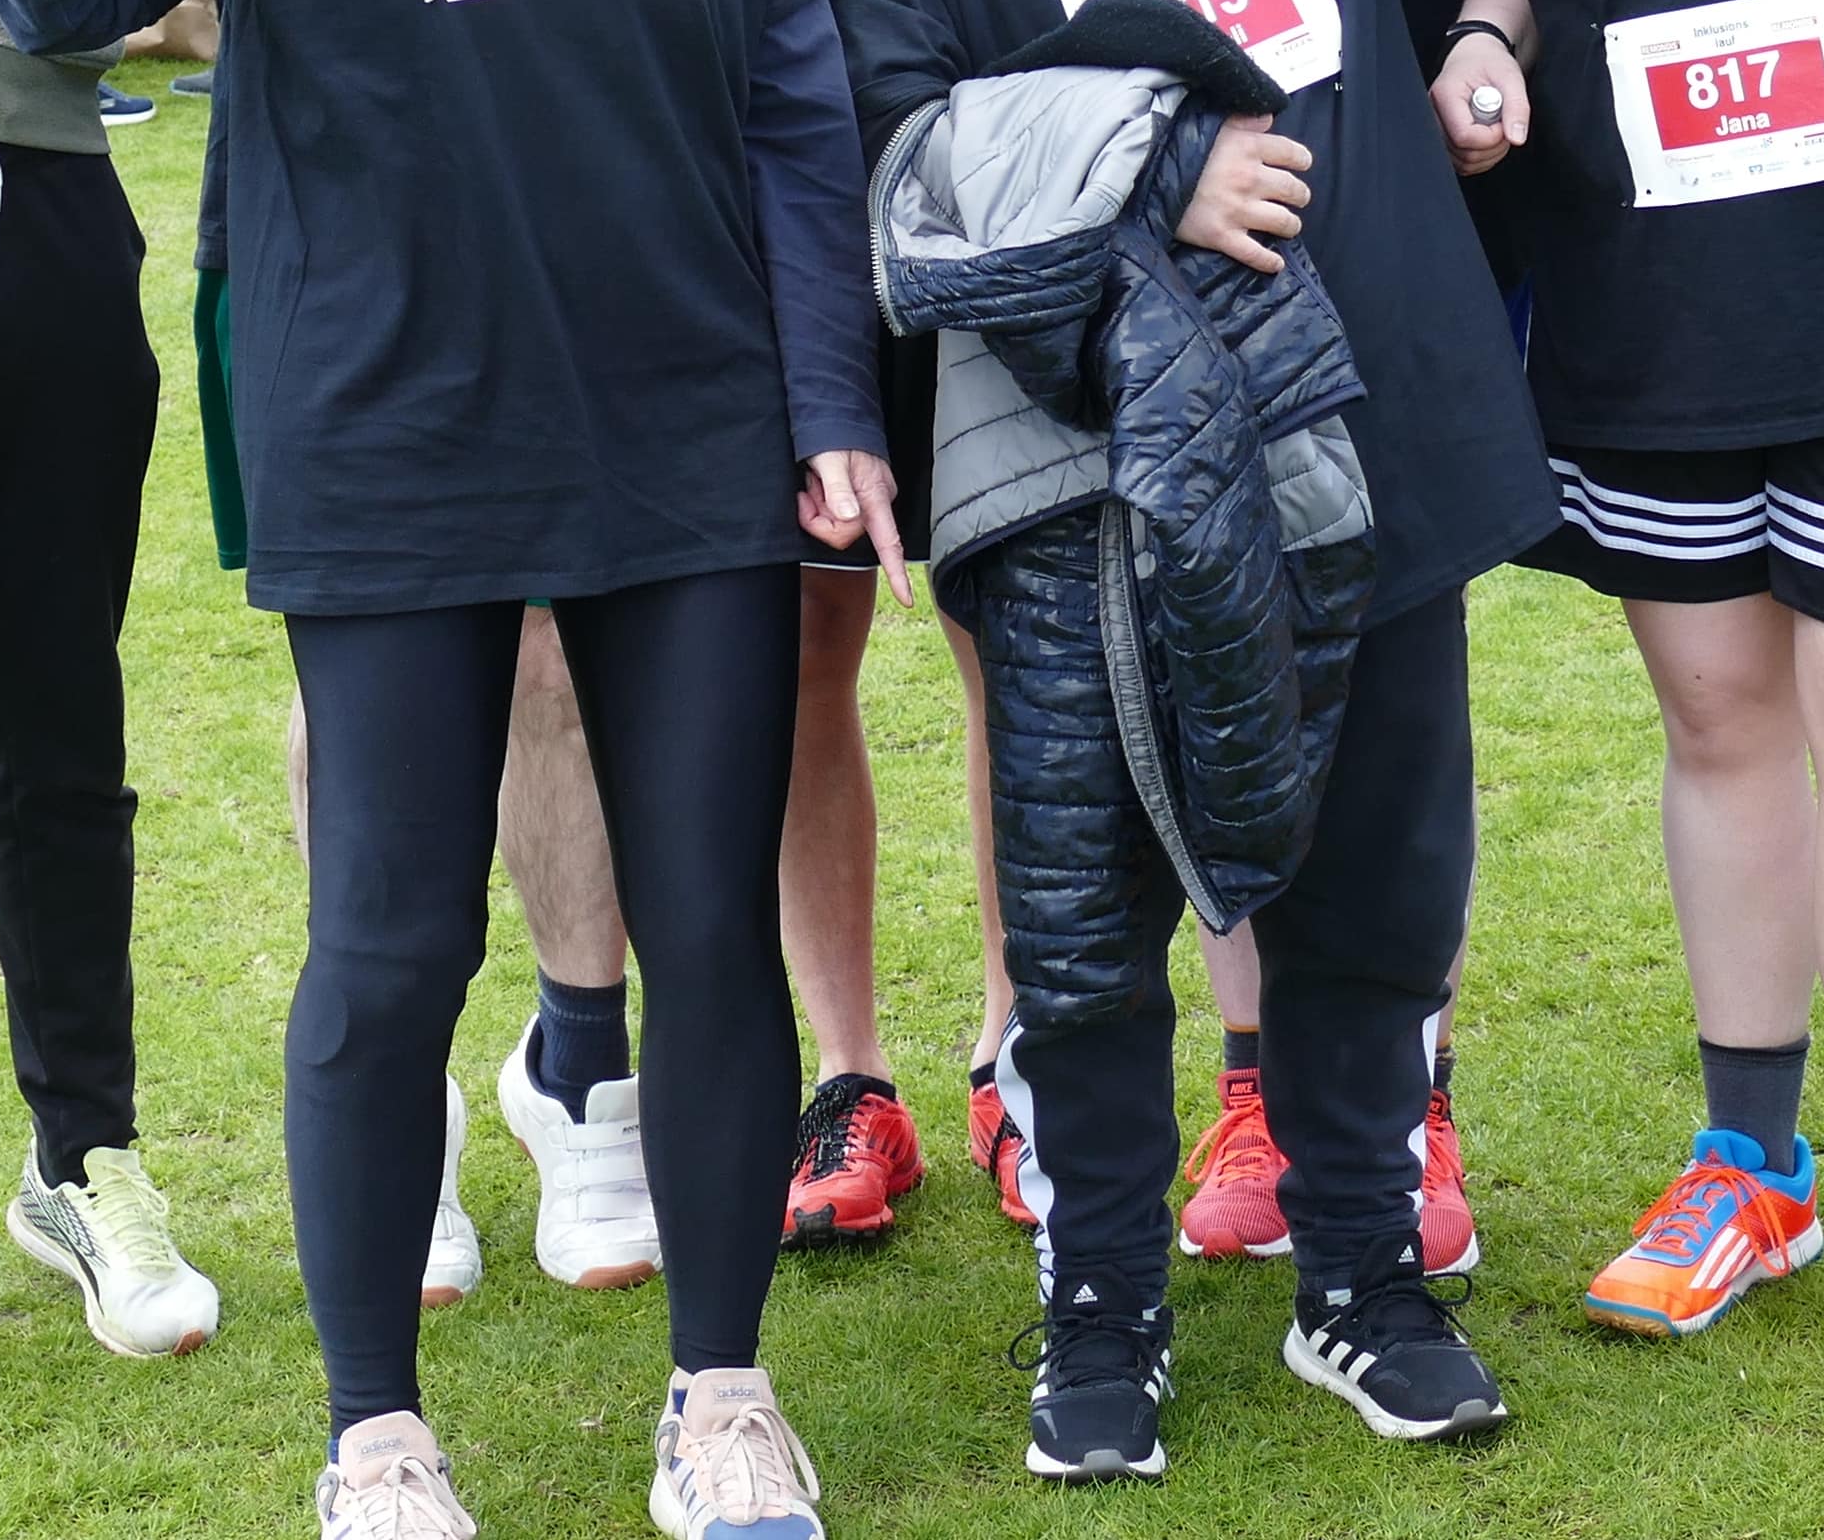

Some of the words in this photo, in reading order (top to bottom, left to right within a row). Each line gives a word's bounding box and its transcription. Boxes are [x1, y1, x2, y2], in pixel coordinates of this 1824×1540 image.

[1685, 48, 1781, 110] 817
[1715, 111, 1771, 138] Jana
[1230, 1082, 1254, 1095] NIKE
[717, 1386, 756, 1398] adidas
[361, 1437, 402, 1454] adidas
